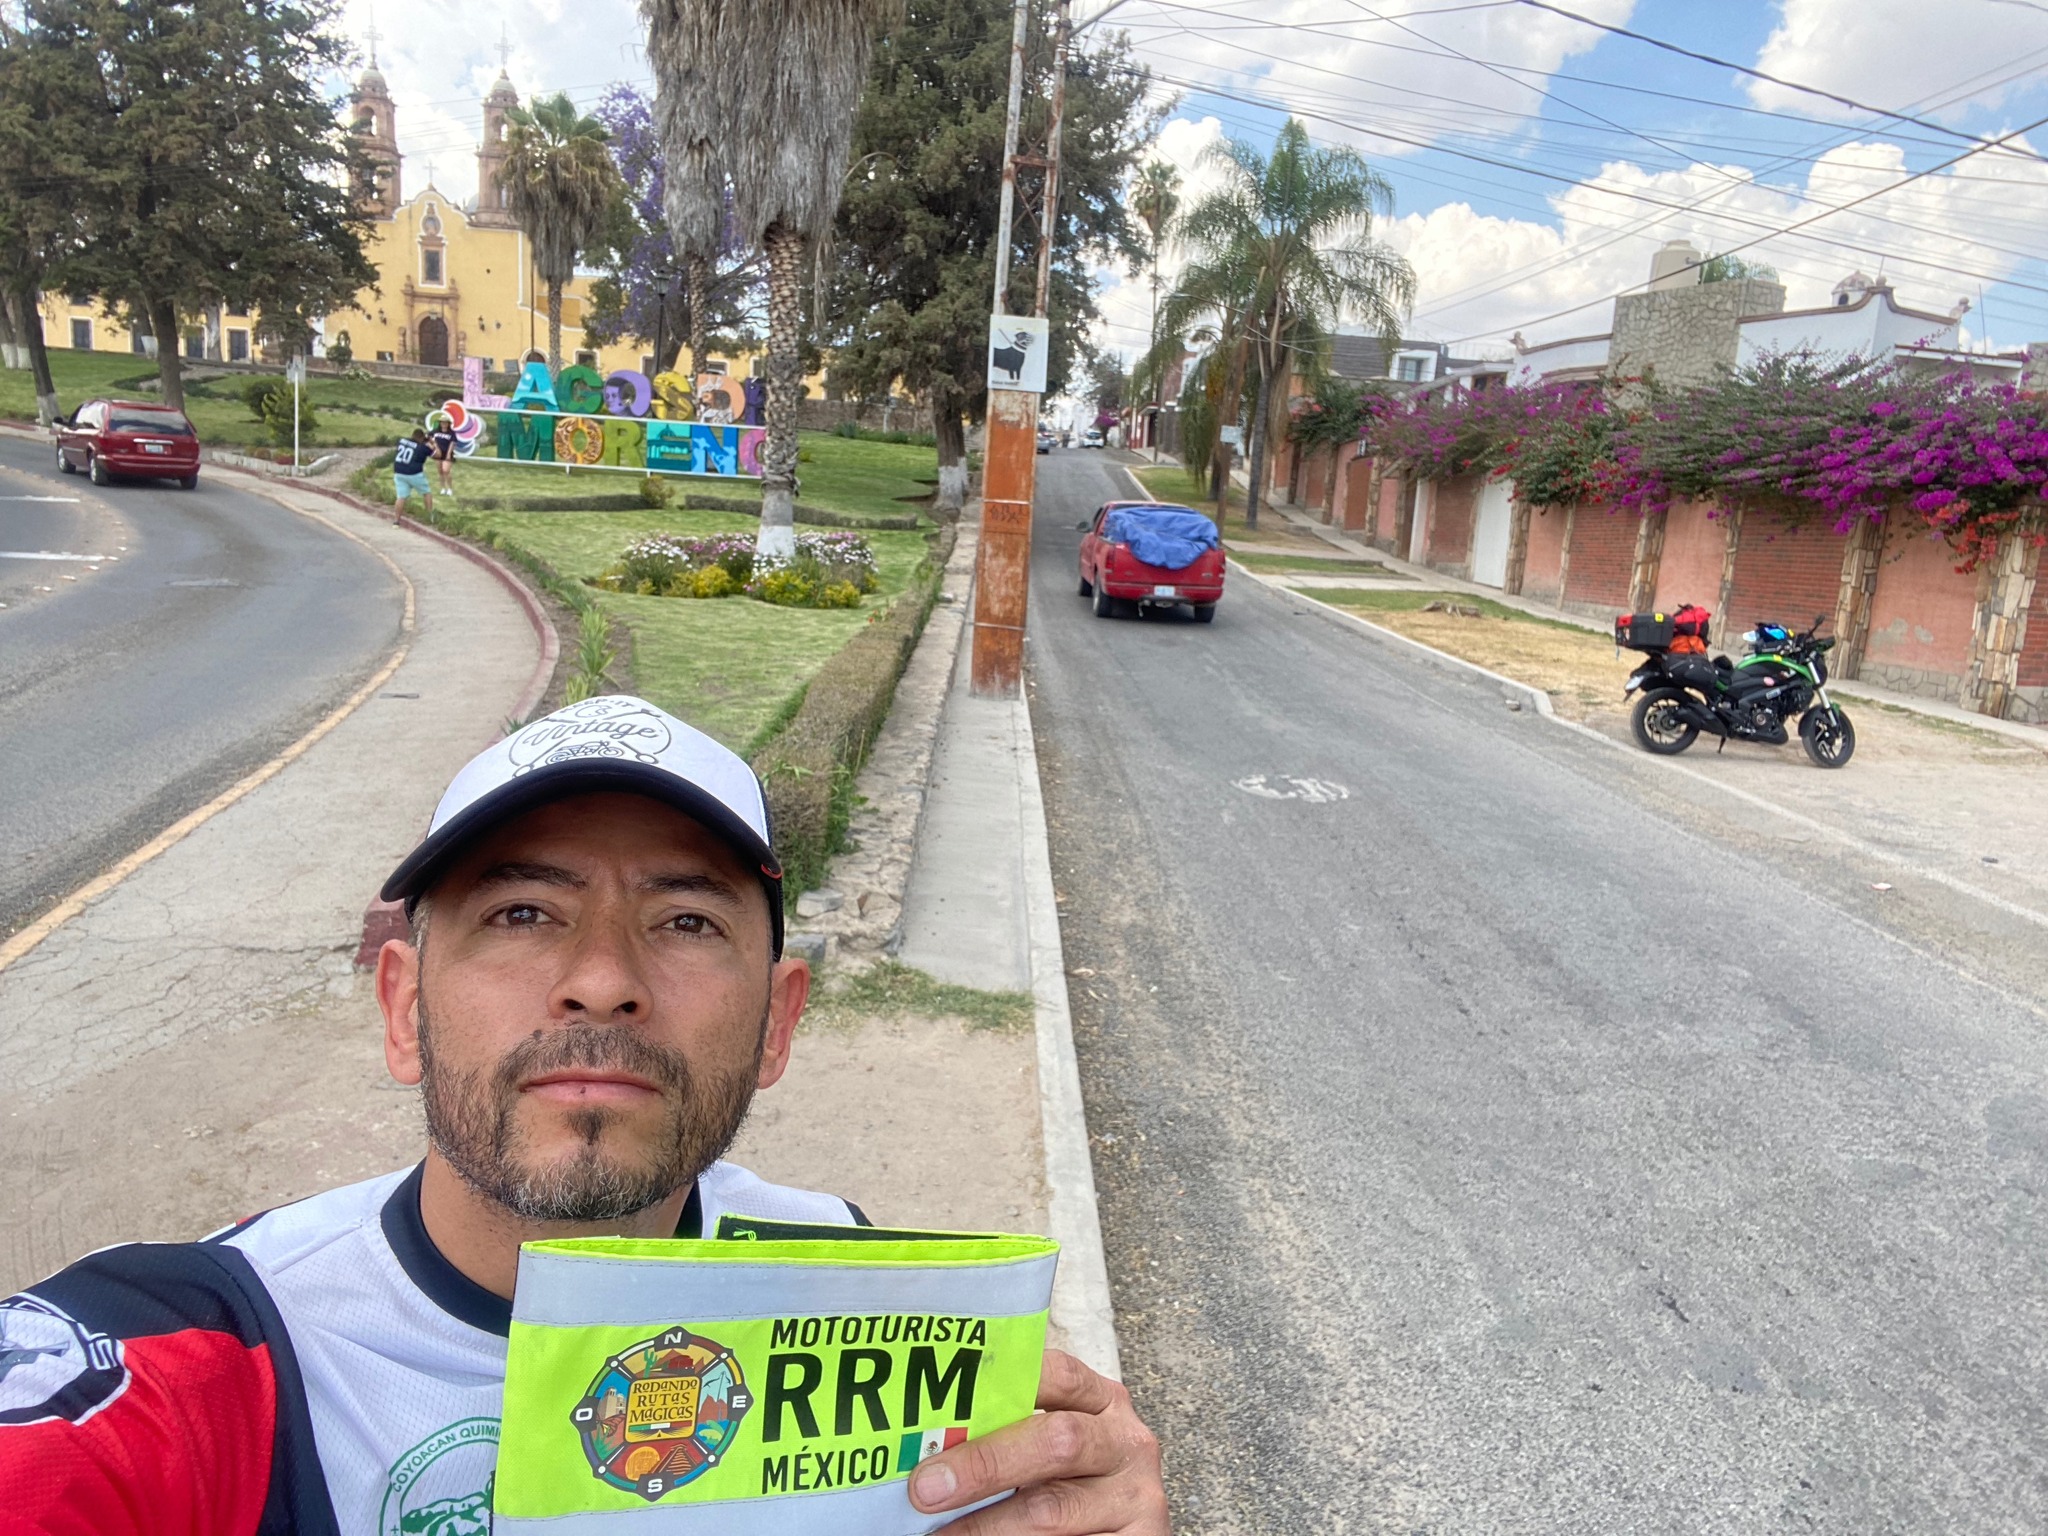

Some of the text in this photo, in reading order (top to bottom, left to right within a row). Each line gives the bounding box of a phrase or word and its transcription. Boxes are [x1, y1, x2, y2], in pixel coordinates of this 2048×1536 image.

[463, 357, 694, 420] LAGOS
[396, 445, 414, 464] 20
[523, 719, 660, 746] Vintage
[664, 1331, 683, 1345] N
[770, 1315, 986, 1349] MOTOTURISTA
[732, 1395, 747, 1409] E
[762, 1346, 983, 1443] RRM
[575, 1407, 593, 1421] O
[391, 1424, 502, 1493] COYOACAN QUIMI
[762, 1445, 889, 1495] MÉXICO
[647, 1478, 663, 1494] S
